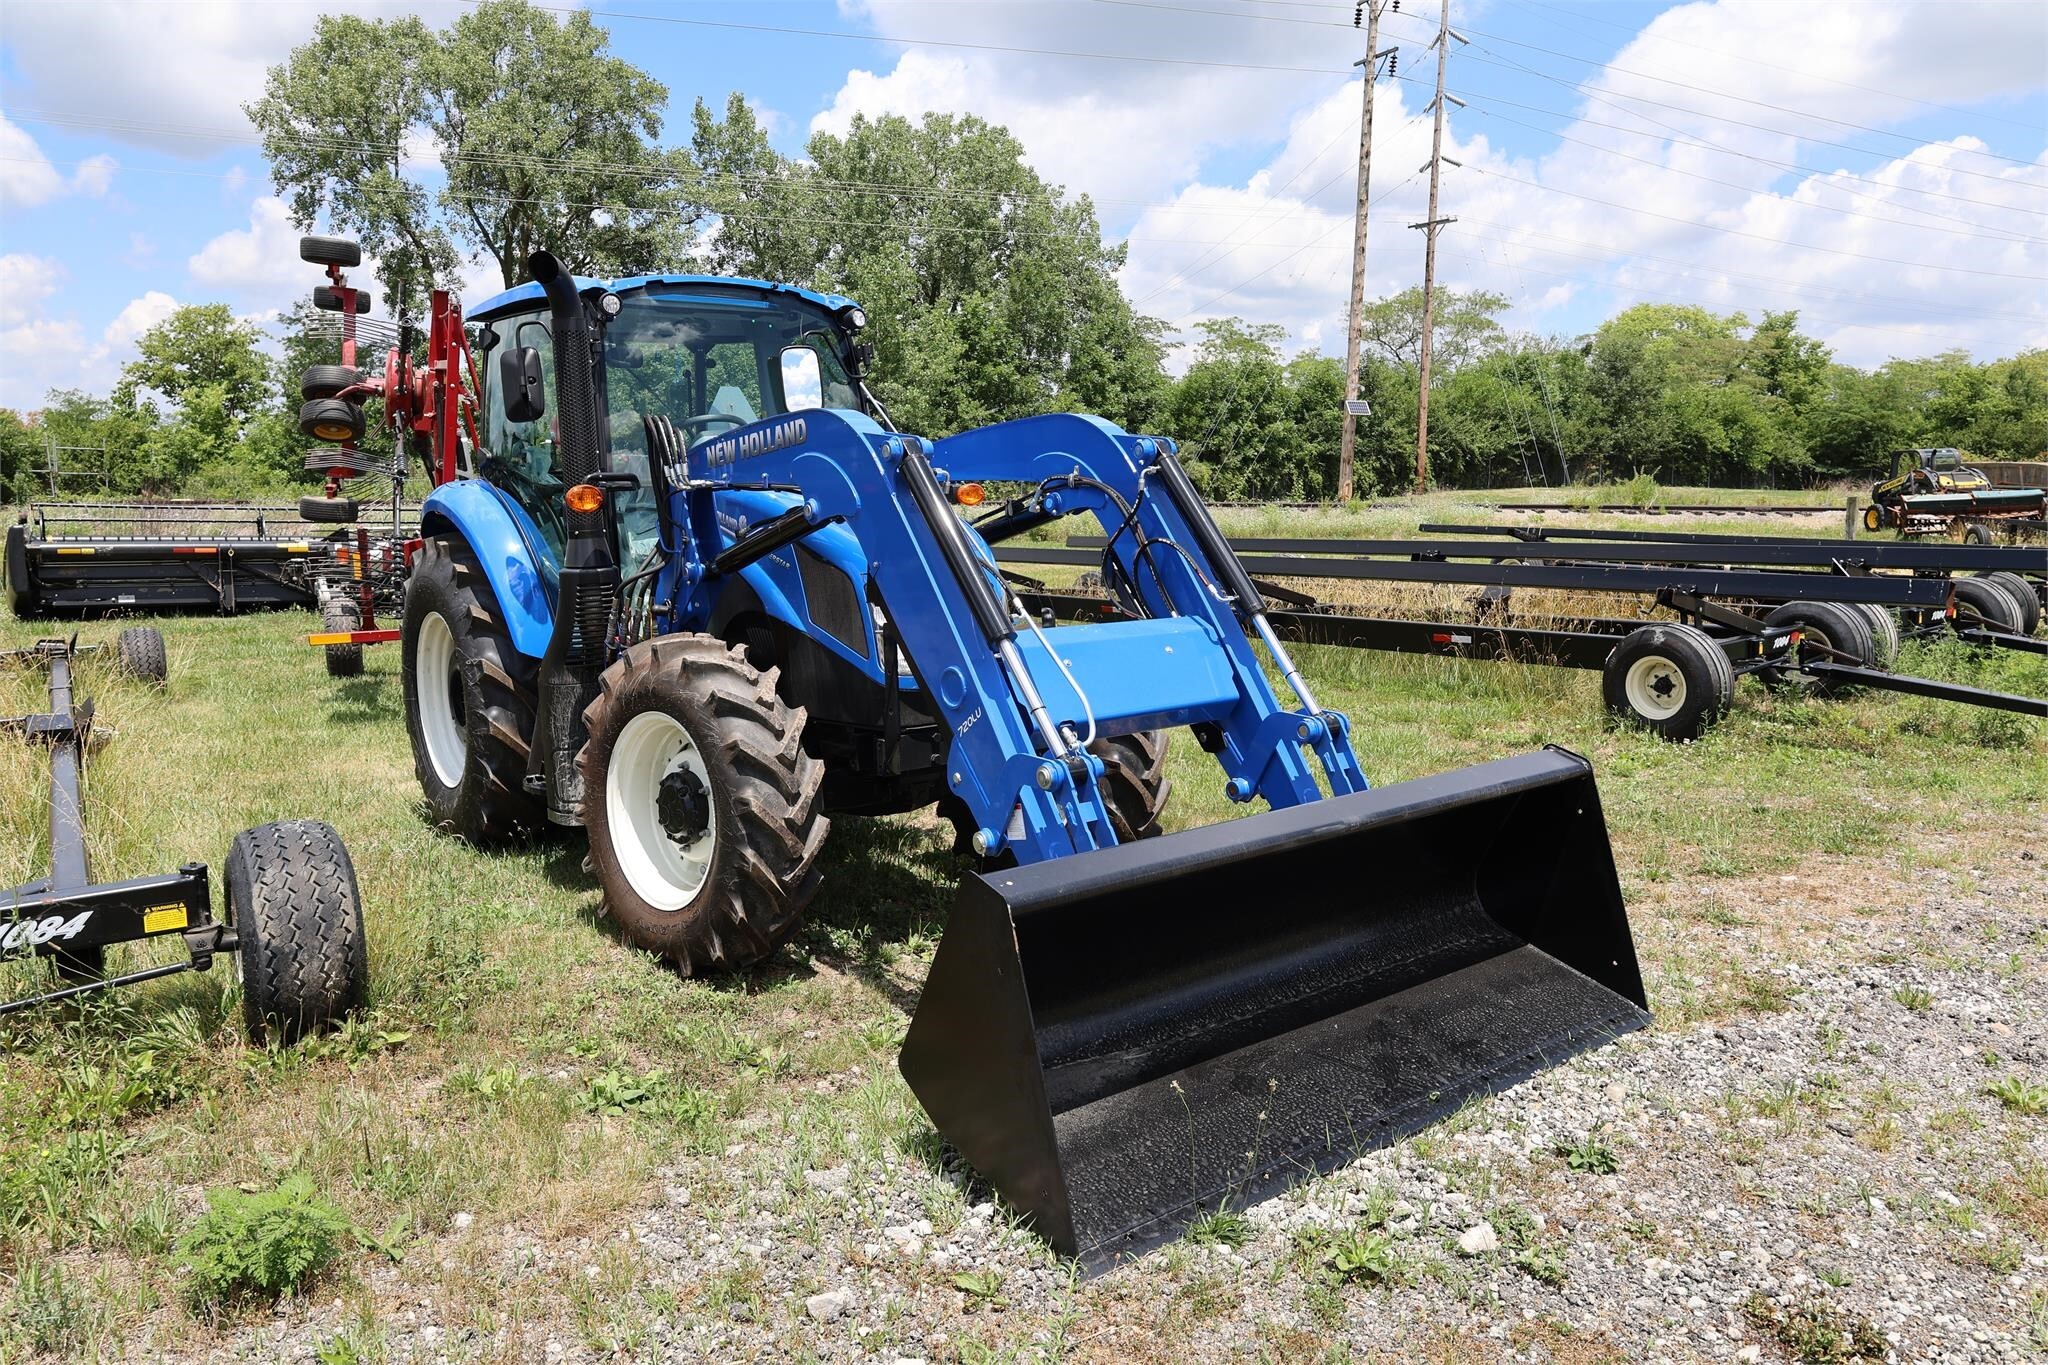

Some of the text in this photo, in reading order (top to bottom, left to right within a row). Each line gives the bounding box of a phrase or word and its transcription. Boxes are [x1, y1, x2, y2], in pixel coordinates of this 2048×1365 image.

[706, 418, 807, 468] NEW HOLLAND
[768, 553, 791, 569] ERSTAR
[957, 706, 982, 738] 720LU
